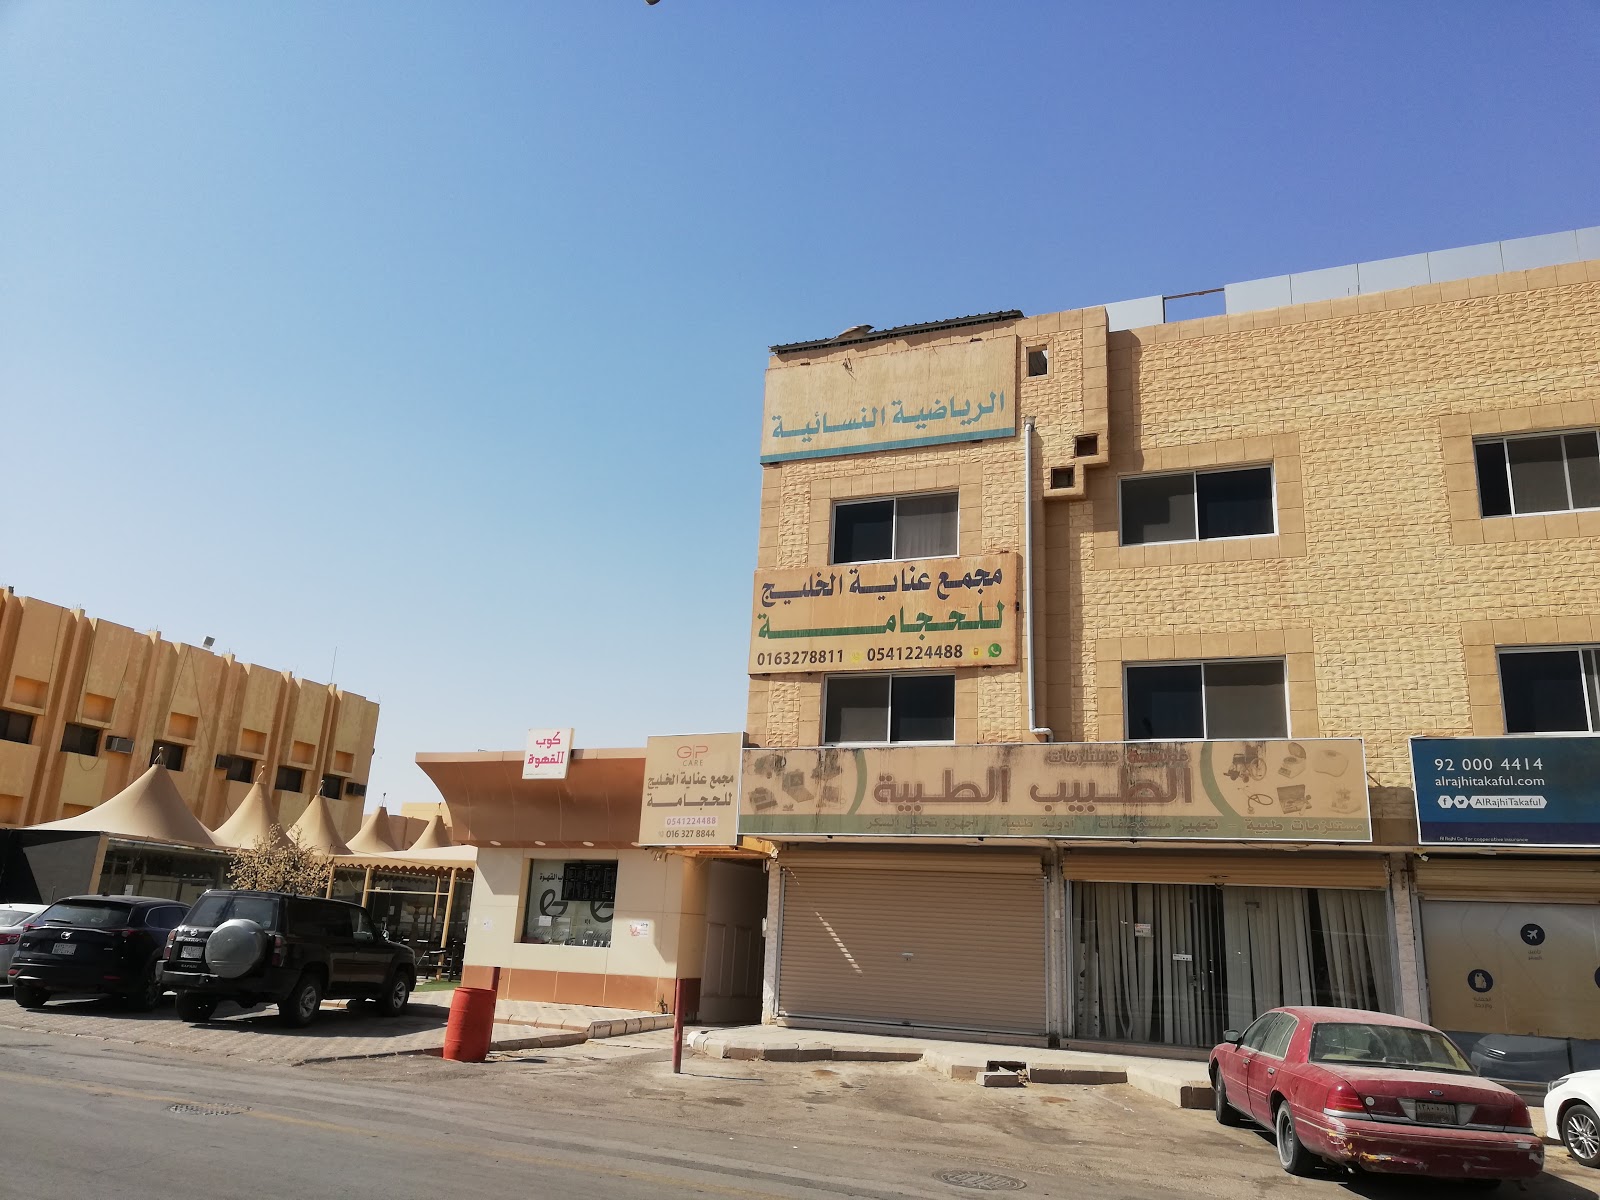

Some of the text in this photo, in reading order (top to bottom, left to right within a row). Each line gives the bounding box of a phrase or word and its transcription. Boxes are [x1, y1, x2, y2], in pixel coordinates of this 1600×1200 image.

[772, 390, 1005, 443] الرياضية النسائية
[761, 565, 1002, 608] مجمع عناية الخليج
[757, 600, 1005, 641] للحجامة
[757, 644, 963, 666] 0163278811 0541224488
[535, 731, 561, 749] كوب
[527, 751, 565, 768] القهوة
[682, 759, 703, 767] CARE
[1434, 757, 1543, 771] 92 000 4414
[647, 772, 734, 790] مجمع عناية الخليج
[873, 766, 1193, 812] الطبيب الطبية
[1434, 775, 1546, 789] alrajhitakaful.com
[646, 792, 733, 810] للحجامة
[1475, 797, 1541, 807] AlRajhiTakaful
[666, 816, 717, 826] 0541224488
[865, 817, 899, 831] السكر
[1180, 818, 1219, 833] تجهيز
[1244, 818, 1284, 834] طبية
[1291, 819, 1364, 835] مستلزمات
[666, 829, 715, 838] 016 327 8844
